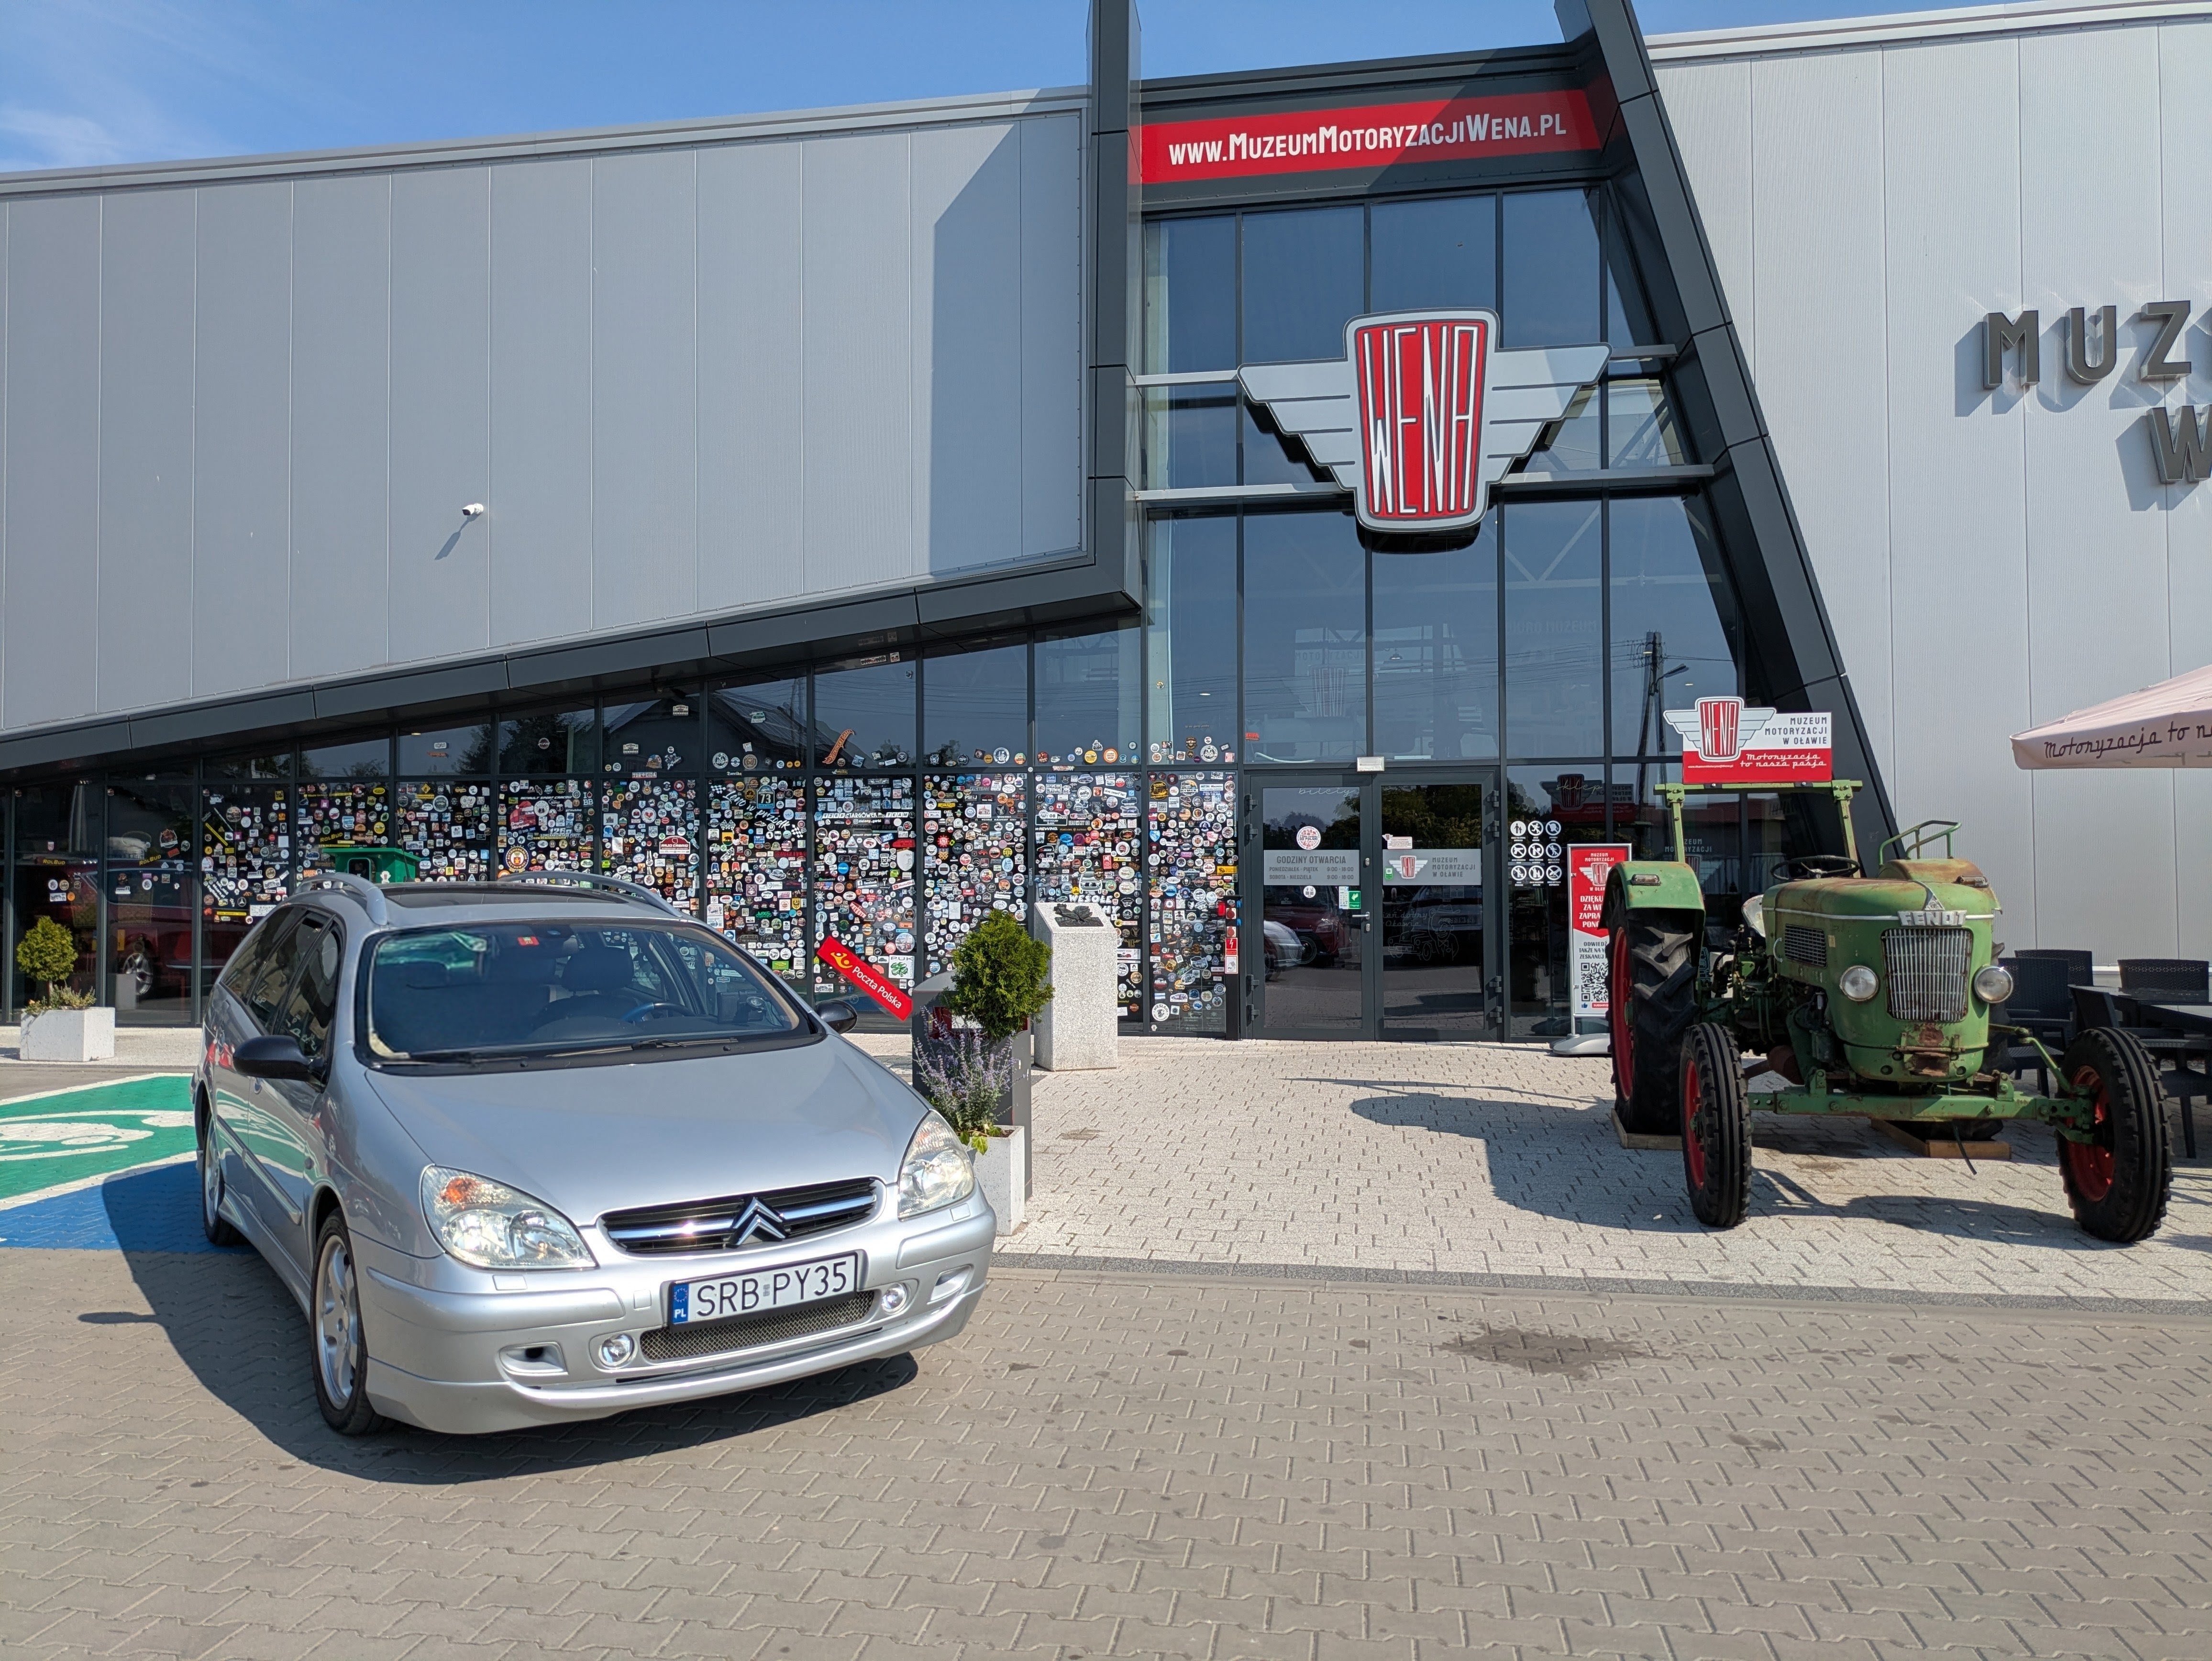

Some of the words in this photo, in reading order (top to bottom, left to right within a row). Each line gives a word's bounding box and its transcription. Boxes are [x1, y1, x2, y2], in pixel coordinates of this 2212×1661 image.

[1983, 300, 2192, 389] MUZ
[1364, 326, 1478, 514] WENA
[1702, 702, 1737, 755] WENA
[1765, 727, 1827, 735] MOTORYZACJI
[2044, 727, 2162, 759] Motoryzacja
[2168, 721, 2190, 742] to
[1792, 760, 1826, 768] pasja
[1556, 779, 1602, 794] sklep
[761, 794, 771, 804] 73
[1069, 895, 1113, 904] WESOŁE
[1899, 910, 1966, 926] FENDT
[852, 966, 878, 990] Poczta
[877, 986, 902, 1009] Polska
[697, 1279, 760, 1317] SRB
[773, 1261, 847, 1305] PY35
[674, 1309, 686, 1318] PL
